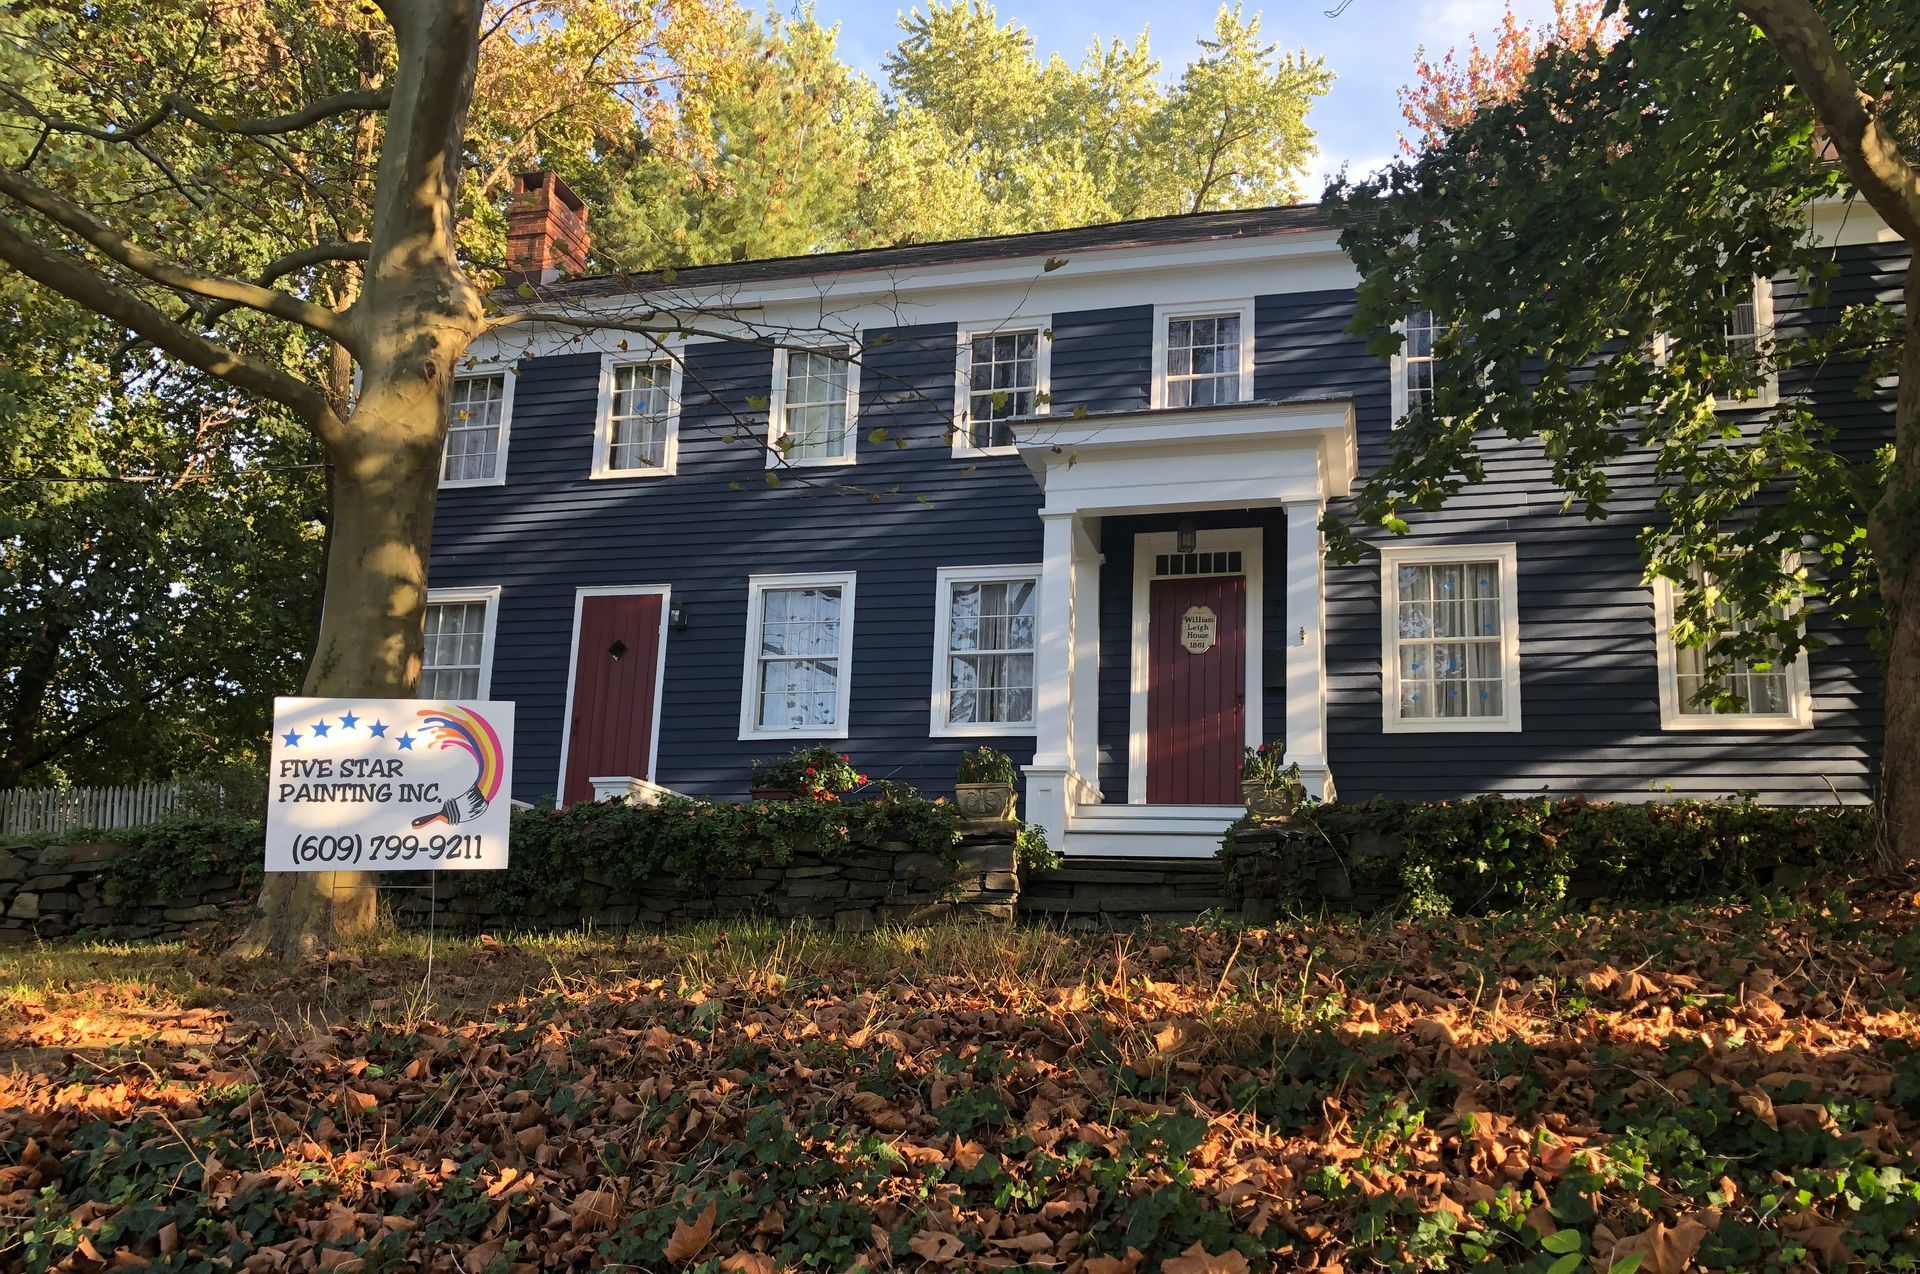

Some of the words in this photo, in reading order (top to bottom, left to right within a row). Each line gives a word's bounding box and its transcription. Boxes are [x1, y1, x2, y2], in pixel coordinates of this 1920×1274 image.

[1187, 624, 1209, 632] Leigh
[280, 759, 332, 778] FIVE
[340, 759, 403, 778] STAR
[279, 783, 392, 803] PAINTING
[399, 783, 442, 803] INC.
[292, 834, 362, 864] (609)
[369, 835, 482, 861] 799-9211
